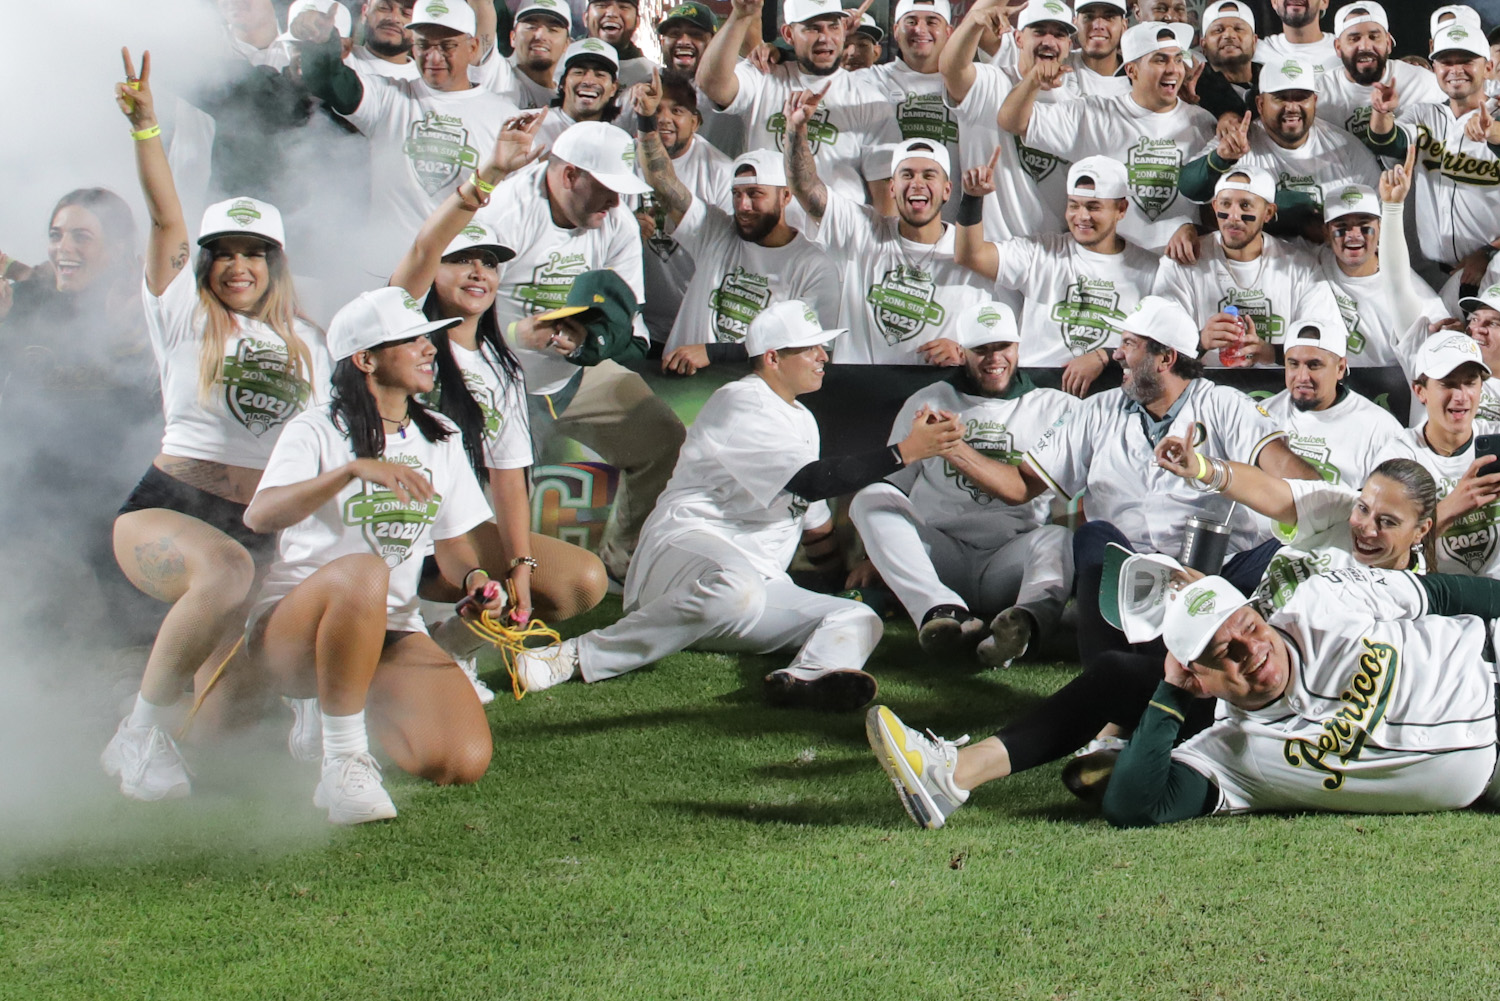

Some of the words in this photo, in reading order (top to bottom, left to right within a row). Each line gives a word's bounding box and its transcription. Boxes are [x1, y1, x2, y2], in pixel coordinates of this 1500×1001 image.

[903, 123, 924, 131] ZONA
[926, 125, 943, 133] SUR
[1137, 135, 1176, 152] Pericos
[440, 148, 459, 158] SUR
[1134, 156, 1177, 166] CAMPEÓN
[416, 160, 452, 175] 2023
[1135, 170, 1158, 178] ZONA
[1159, 171, 1176, 180] SUR
[1138, 185, 1171, 198] 2023
[545, 252, 585, 272] Pericos
[886, 282, 929, 300] CAMPEÓN
[1076, 275, 1116, 292] Pericos
[536, 292, 562, 301] ZONA
[725, 285, 763, 305] CAMPEÓN
[1226, 287, 1265, 305] Pericos
[883, 296, 906, 308] ZONA
[907, 302, 925, 314] SUR
[881, 310, 918, 331] 2023
[1069, 324, 1102, 340] 2023
[239, 389, 288, 415] 2023
[965, 419, 1007, 438] Pericos
[1289, 431, 1326, 446] Pericos
[374, 500, 408, 514] ZONA
[409, 500, 428, 512] SUR
[1468, 511, 1487, 523] SUR
[1448, 529, 1489, 550] 2023
[381, 545, 406, 557] LMB
[1283, 637, 1398, 791] Pericos
